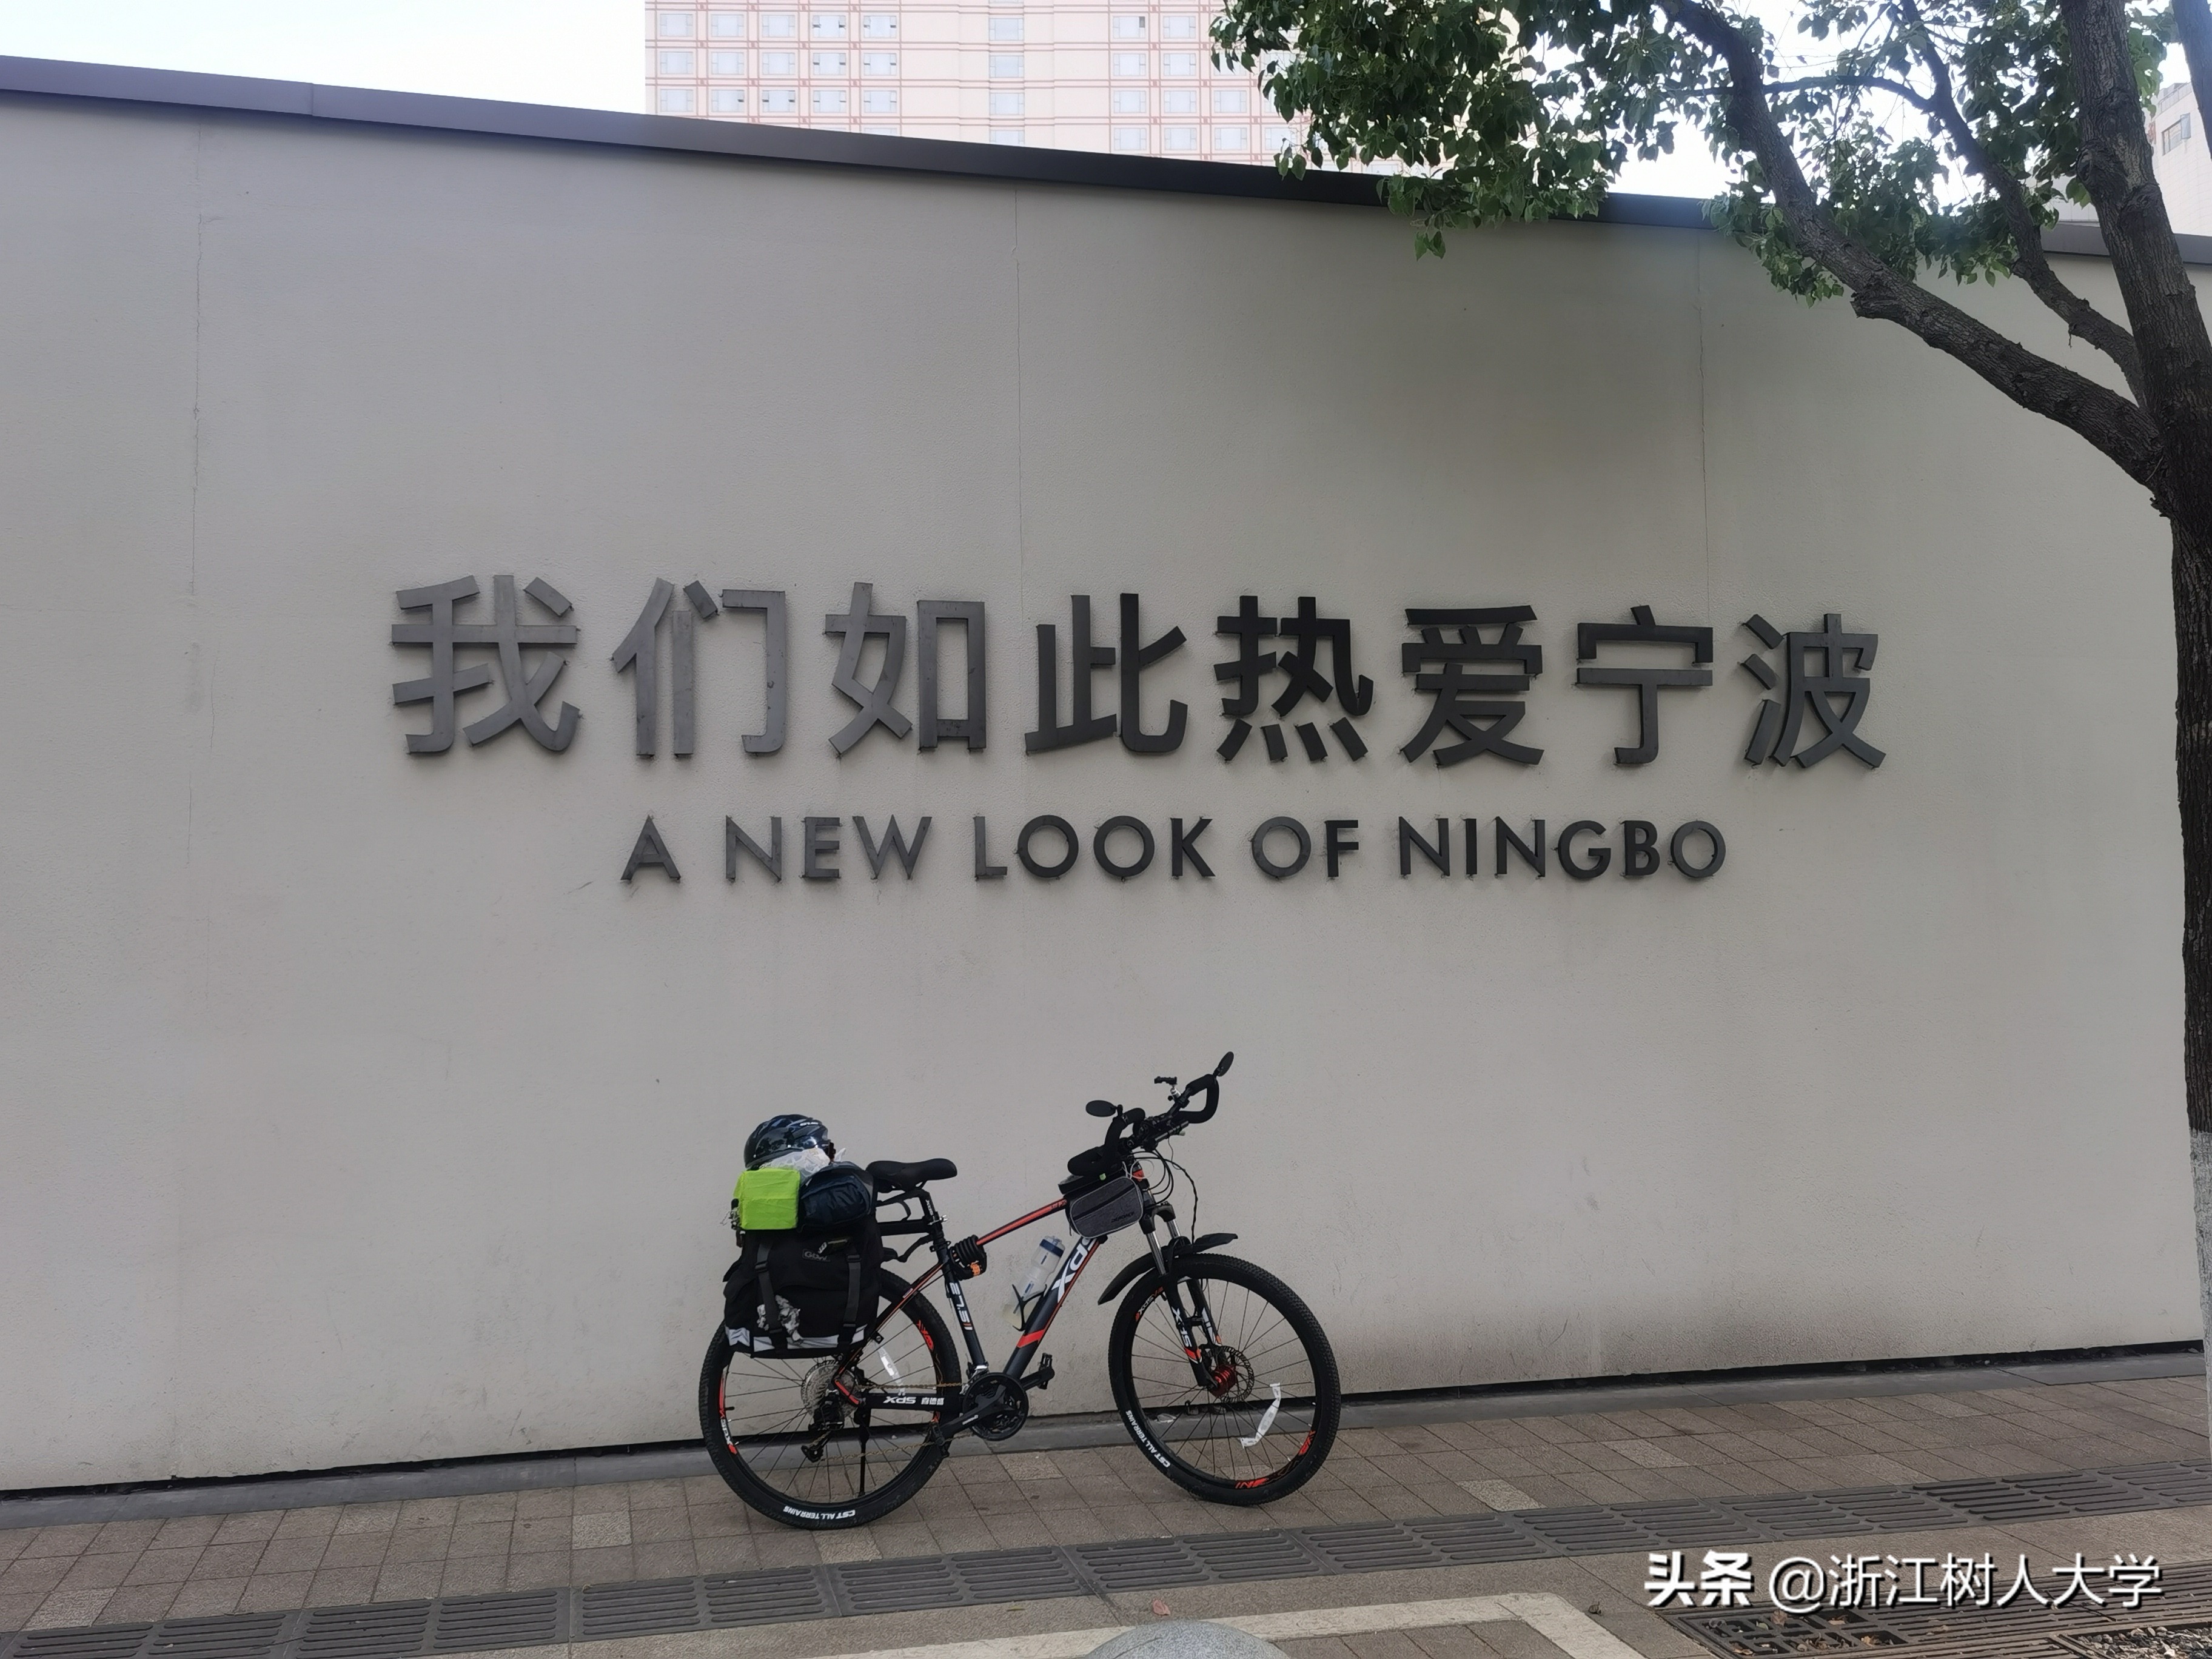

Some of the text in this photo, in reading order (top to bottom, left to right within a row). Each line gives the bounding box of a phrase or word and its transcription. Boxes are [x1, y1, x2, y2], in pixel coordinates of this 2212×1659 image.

[390, 575, 1886, 769] 我们如此热爱宁波
[620, 814, 1726, 881] A NEW LOOK OF NINGBO
[1125, 1410, 1171, 1468] CST ALL TERRAINS
[783, 1505, 820, 1520] TERRAINS
[836, 1509, 856, 1520] CST
